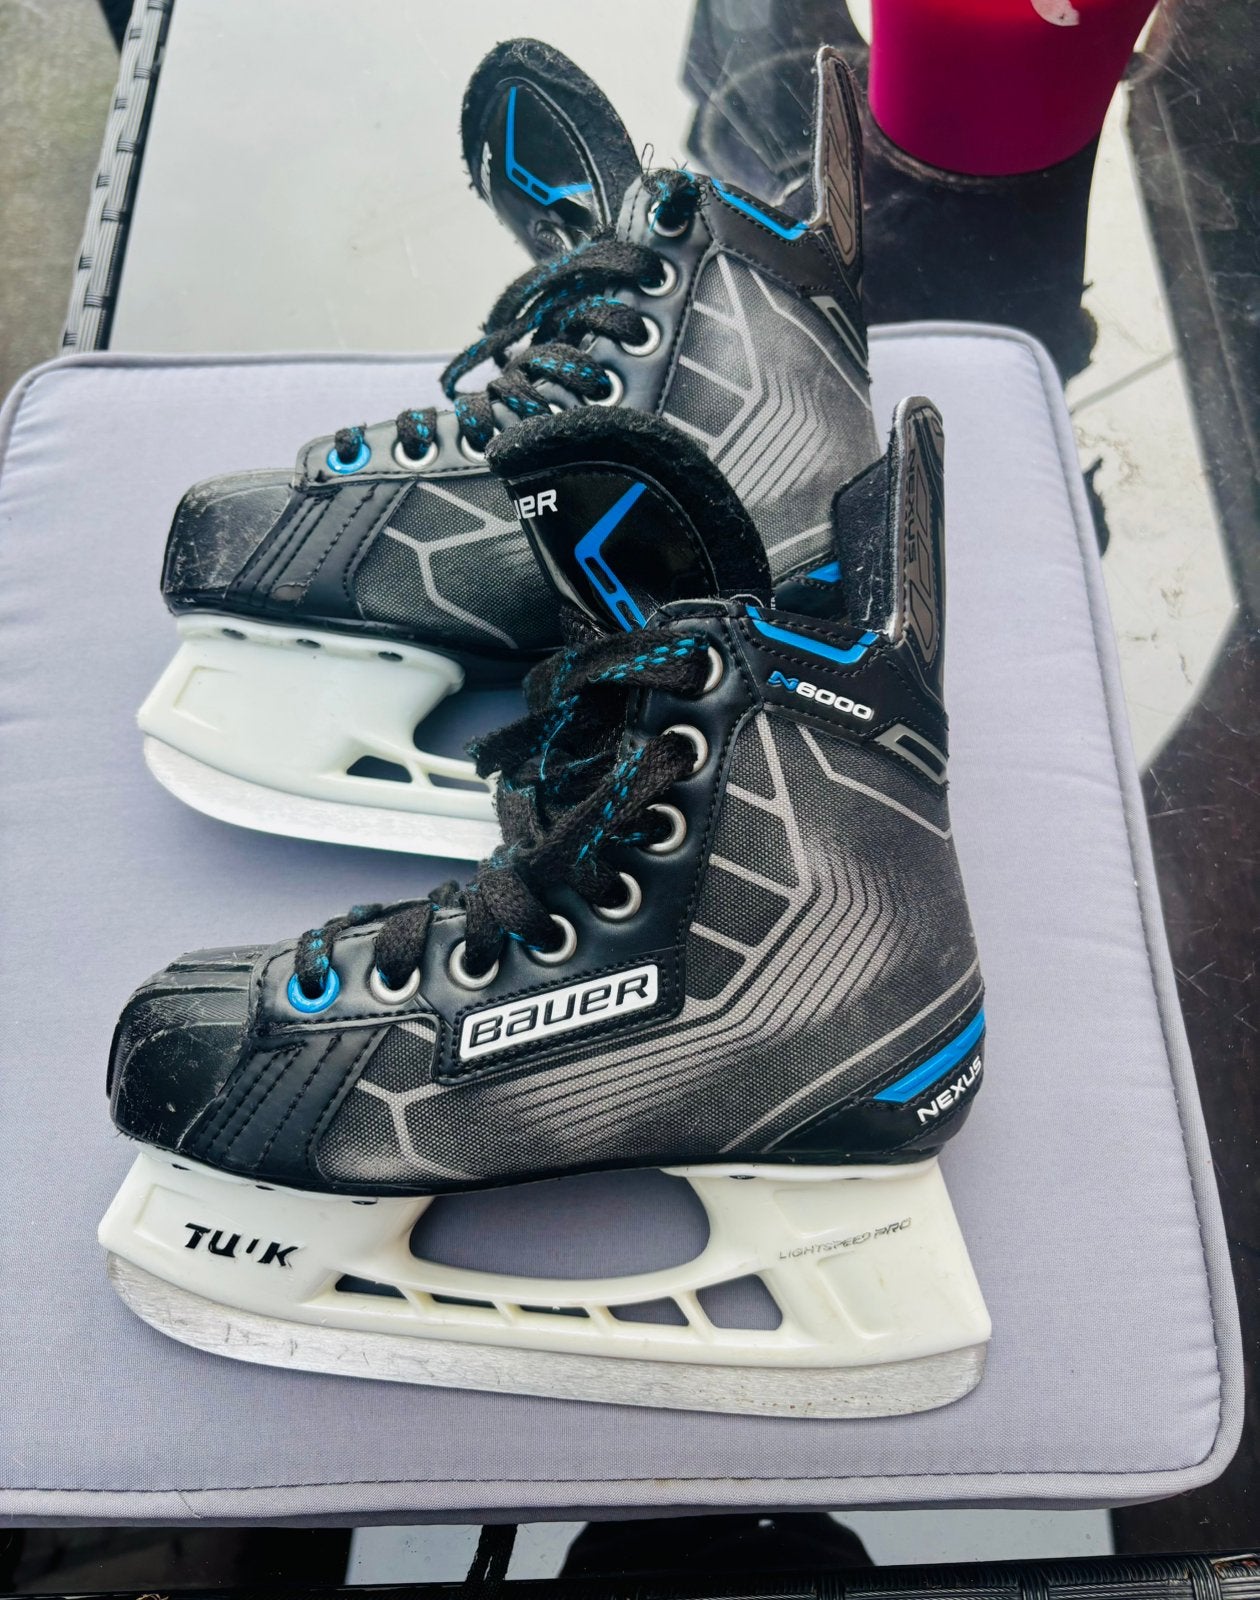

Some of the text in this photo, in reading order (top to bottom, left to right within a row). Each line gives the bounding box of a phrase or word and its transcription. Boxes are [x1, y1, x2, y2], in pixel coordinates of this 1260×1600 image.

[907, 447, 917, 563] NEXUS
[917, 1055, 982, 1124] NEXUS
[779, 1217, 912, 1260] LIGHTSPEED PRO
